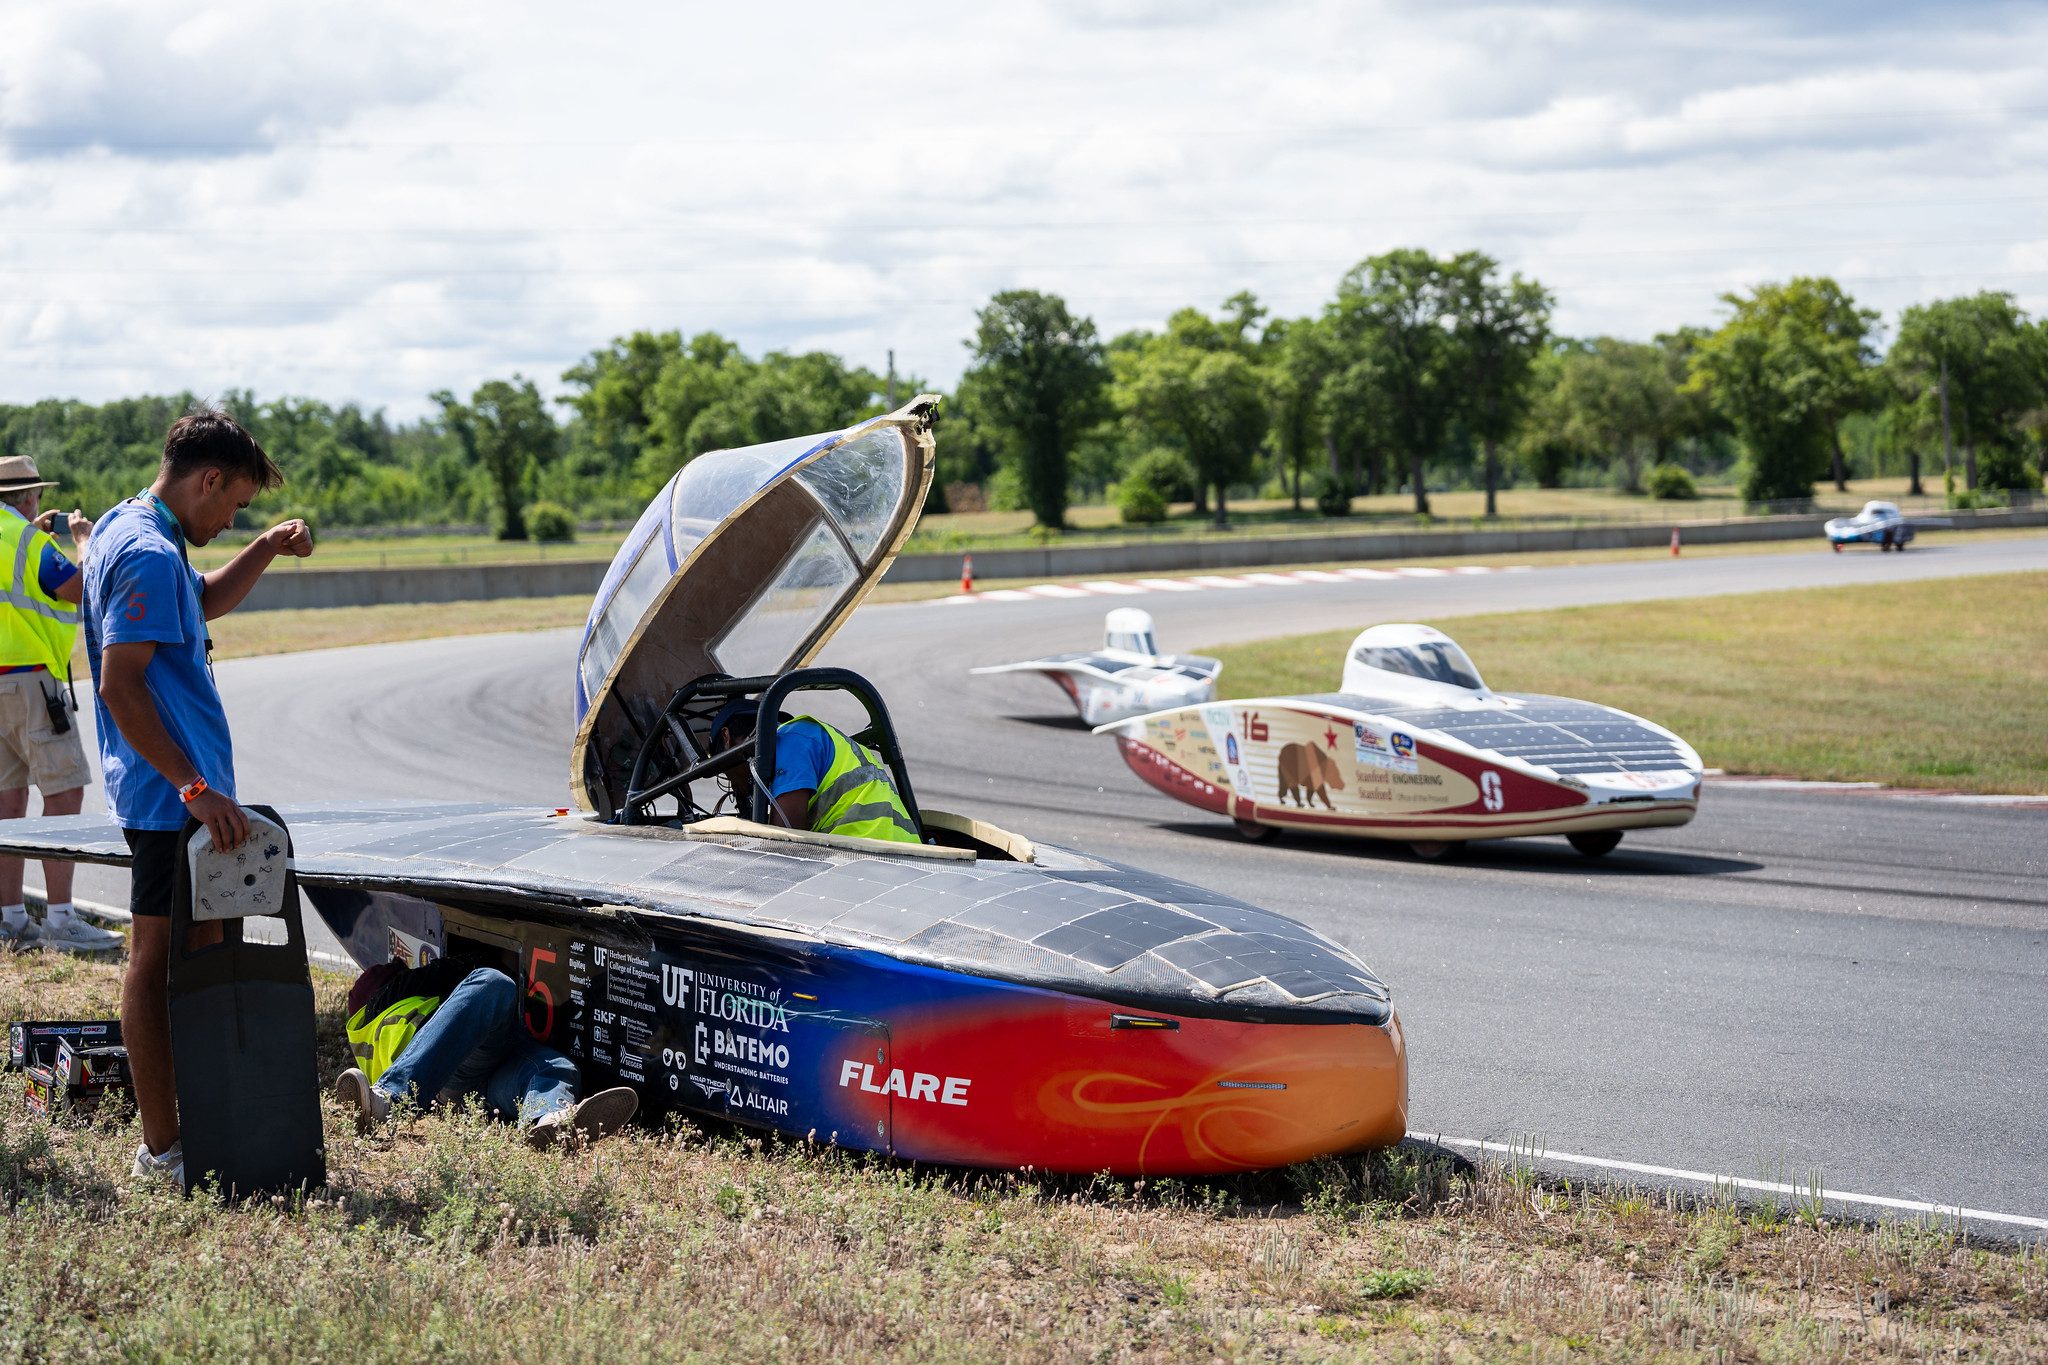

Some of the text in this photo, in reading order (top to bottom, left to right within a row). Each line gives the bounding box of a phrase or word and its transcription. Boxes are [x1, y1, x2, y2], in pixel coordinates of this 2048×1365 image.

[125, 593, 146, 621] 5
[1243, 711, 1269, 742] 16
[1356, 769, 1443, 785] Stanford ENGINEERING
[1358, 786, 1392, 801] Stanford
[594, 946, 607, 967] UF
[610, 950, 627, 962] Herbert
[610, 961, 626, 974] College
[632, 967, 660, 983] Engineering
[525, 947, 557, 1041] 5
[662, 963, 693, 1008] UF
[700, 972, 781, 1005] UNIVERSITY of
[594, 1009, 616, 1024] SKF
[699, 987, 789, 1033] FLORIDA
[715, 1030, 789, 1068] BATEMO
[625, 1060, 642, 1069] SEGGER
[714, 1061, 788, 1084] UNDERSTANDING BATTERIES
[839, 1059, 972, 1107] FLARE
[746, 1092, 788, 1115] ALTAIR
